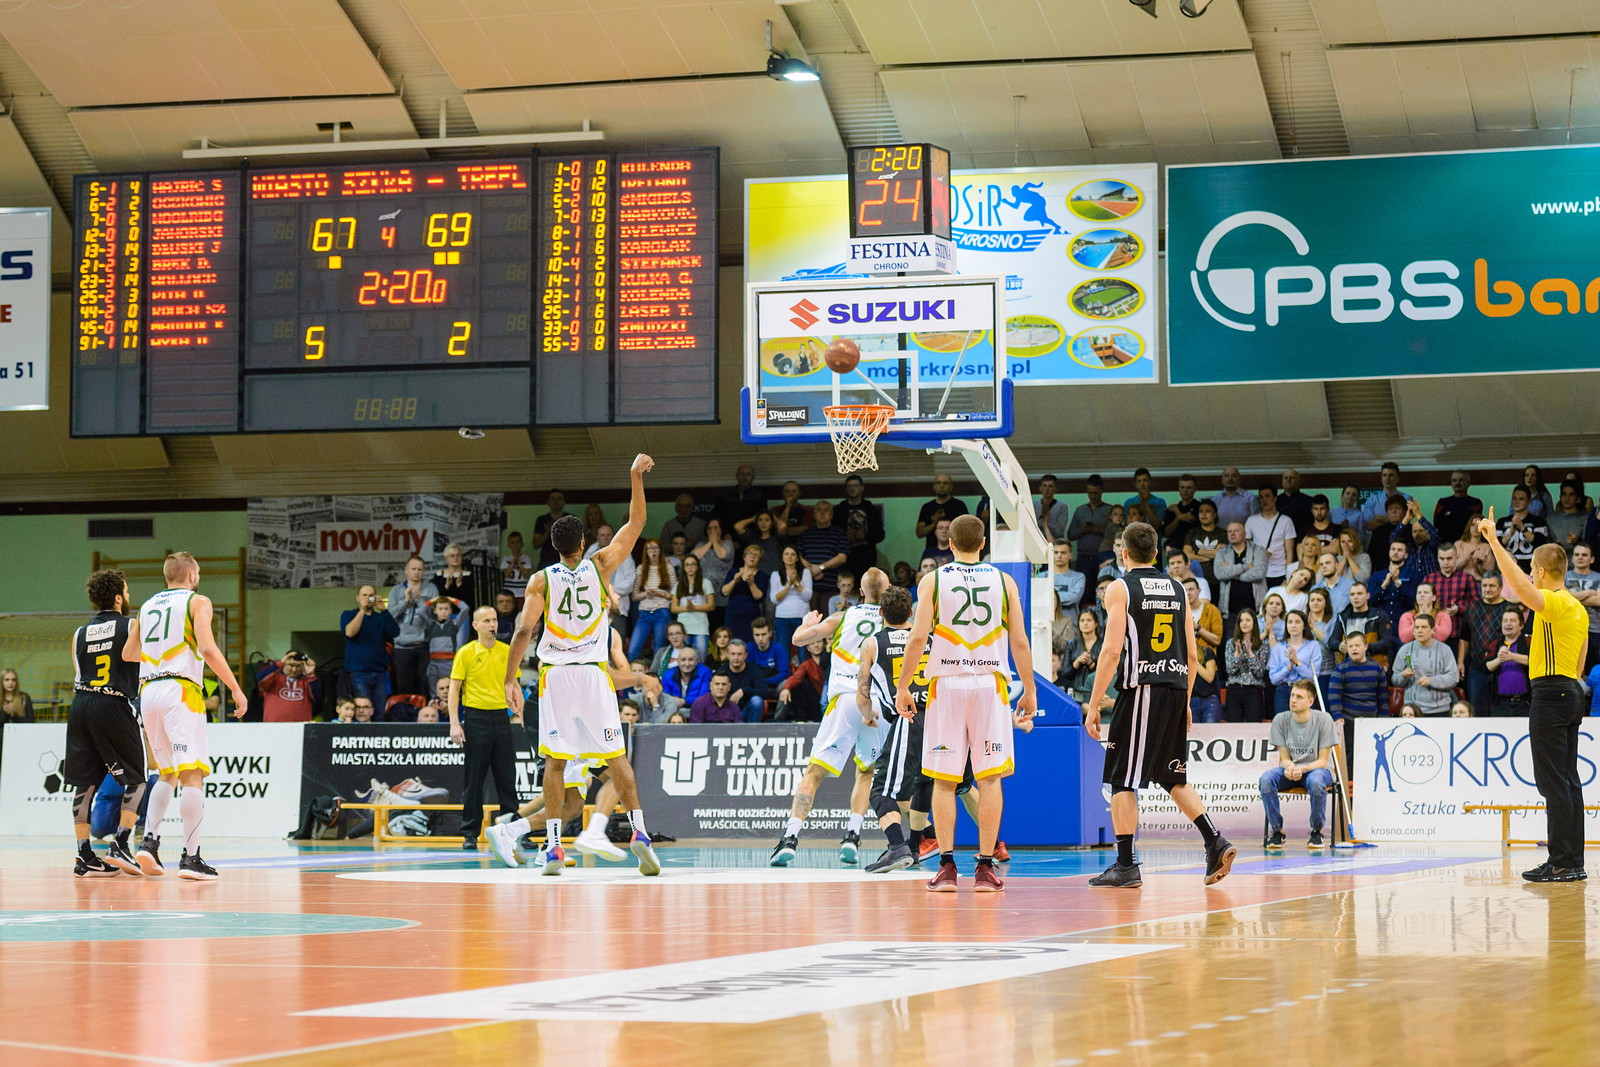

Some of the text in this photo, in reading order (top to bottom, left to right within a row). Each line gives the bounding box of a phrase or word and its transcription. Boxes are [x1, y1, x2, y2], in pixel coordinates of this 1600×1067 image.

[871, 146, 922, 172] 2:20
[596, 160, 606, 174] 0
[130, 181, 140, 194] 4
[591, 176, 606, 190] 12
[129, 196, 140, 211] 2
[591, 192, 606, 206] 10
[858, 180, 922, 226] 24
[129, 211, 140, 226] 2
[591, 208, 606, 222] 13
[129, 226, 140, 241] 0
[312, 217, 357, 252] 67
[381, 227, 396, 248] 4
[426, 212, 472, 248] 69
[595, 224, 606, 239] 8
[595, 240, 605, 254] 6
[960, 234, 1024, 248] KROSNO
[125, 242, 140, 256] 14
[850, 242, 931, 260] FESTINA
[129, 257, 140, 272] 3
[594, 256, 605, 270] 2
[874, 262, 909, 270] CHRONO
[124, 273, 139, 287] 14
[594, 272, 605, 287] 0
[128, 288, 139, 303] 3
[595, 288, 605, 302] 4
[1265, 259, 1464, 327] PBS
[128, 303, 139, 318] 0
[594, 303, 605, 318] 6
[827, 300, 955, 324] SUZUKI
[124, 319, 139, 333] 14
[594, 319, 605, 334] 0
[123, 335, 138, 349] 11
[305, 326, 325, 360] 5
[448, 321, 471, 356] 2
[594, 335, 605, 350] 8
[14, 361, 34, 379] 51
[768, 409, 806, 420] SPALDING
[320, 522, 428, 556] nowiny
[1154, 582, 1172, 591] Trefl
[557, 586, 594, 621] 45
[951, 586, 992, 626] 25
[145, 606, 171, 643] 21
[1151, 614, 1173, 652] 5
[87, 641, 113, 653] IRELAND
[90, 654, 110, 686] 3
[1138, 659, 1166, 674] Trefl
[332, 737, 390, 749] PARTNER
[331, 753, 376, 765] MIASTA
[377, 753, 415, 765] SZKŁA
[713, 737, 814, 766] TEXTIL
[1401, 755, 1435, 767] 1923
[694, 809, 736, 818] PARTNER
[738, 806, 792, 818] ODZIEŻOWY
[1402, 800, 1456, 816] Sztuka
[699, 819, 839, 830] WŁAŚCICIEL MARKI SPORT
[1371, 827, 1435, 836] krosno.com.pl
